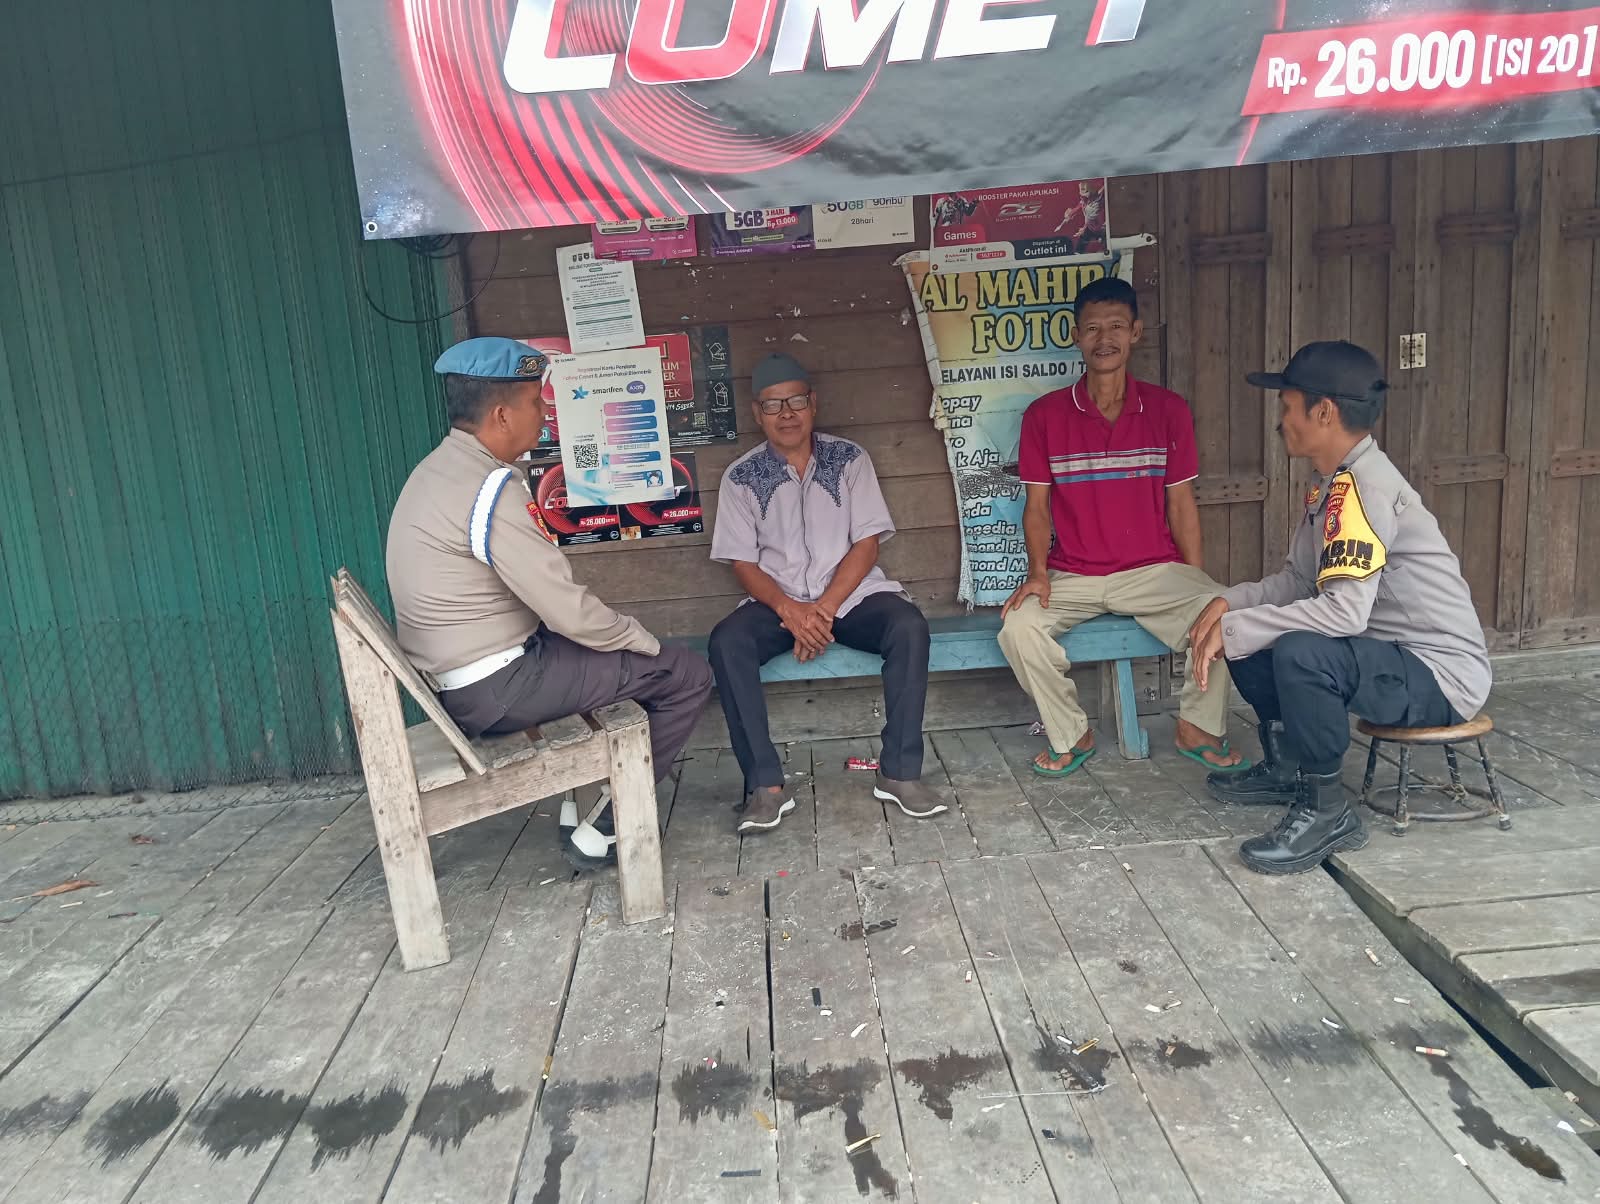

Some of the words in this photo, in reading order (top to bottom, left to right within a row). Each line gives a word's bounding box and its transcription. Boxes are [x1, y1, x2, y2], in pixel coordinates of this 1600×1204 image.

[1267, 57, 1308, 95] Rp.
[1314, 29, 1476, 98] 26.000
[1481, 34, 1533, 85] [ISI
[1537, 24, 1599, 77] 20]
[978, 192, 1008, 201] BOOSTER
[1008, 191, 1029, 199] PAKAI
[1029, 188, 1059, 197] APLIKASI
[733, 209, 765, 228] 5GB
[943, 231, 977, 241] Games
[1023, 245, 1053, 256] Outlet
[1054, 244, 1067, 254] ini
[921, 273, 968, 312] AL
[972, 309, 1076, 353] FOTO
[662, 361, 680, 371] UM
[940, 366, 996, 383] ELAYANI
[1000, 365, 1018, 379] ISI
[1022, 362, 1067, 378] SALDO
[663, 371, 676, 381] ER
[592, 386, 624, 395] smartfren
[664, 388, 681, 398] TEK
[941, 395, 981, 413] opay
[949, 416, 973, 429] na
[970, 448, 1000, 468] Aja
[531, 467, 545, 476] NEW
[964, 520, 1016, 540] opedia
[969, 557, 1008, 572] mond
